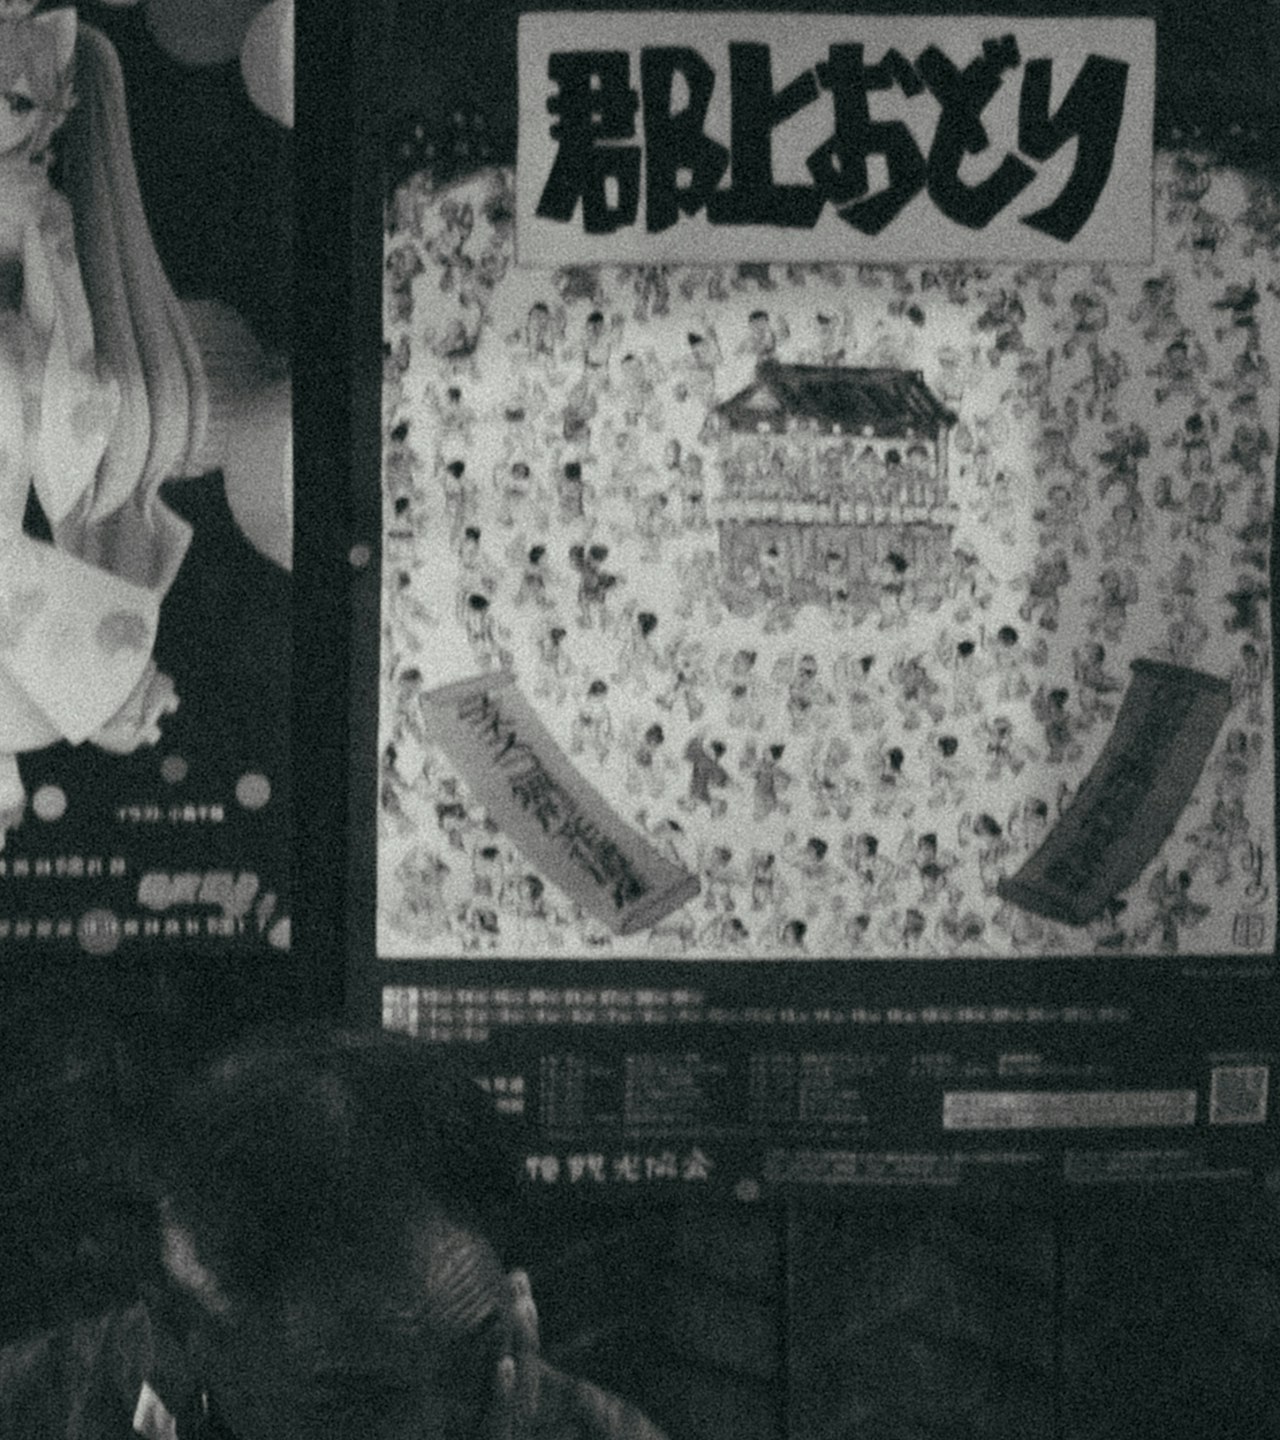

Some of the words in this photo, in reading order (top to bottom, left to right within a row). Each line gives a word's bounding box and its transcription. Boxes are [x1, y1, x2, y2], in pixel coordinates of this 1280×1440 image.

[534, 33, 1132, 244] 郡上おどり
